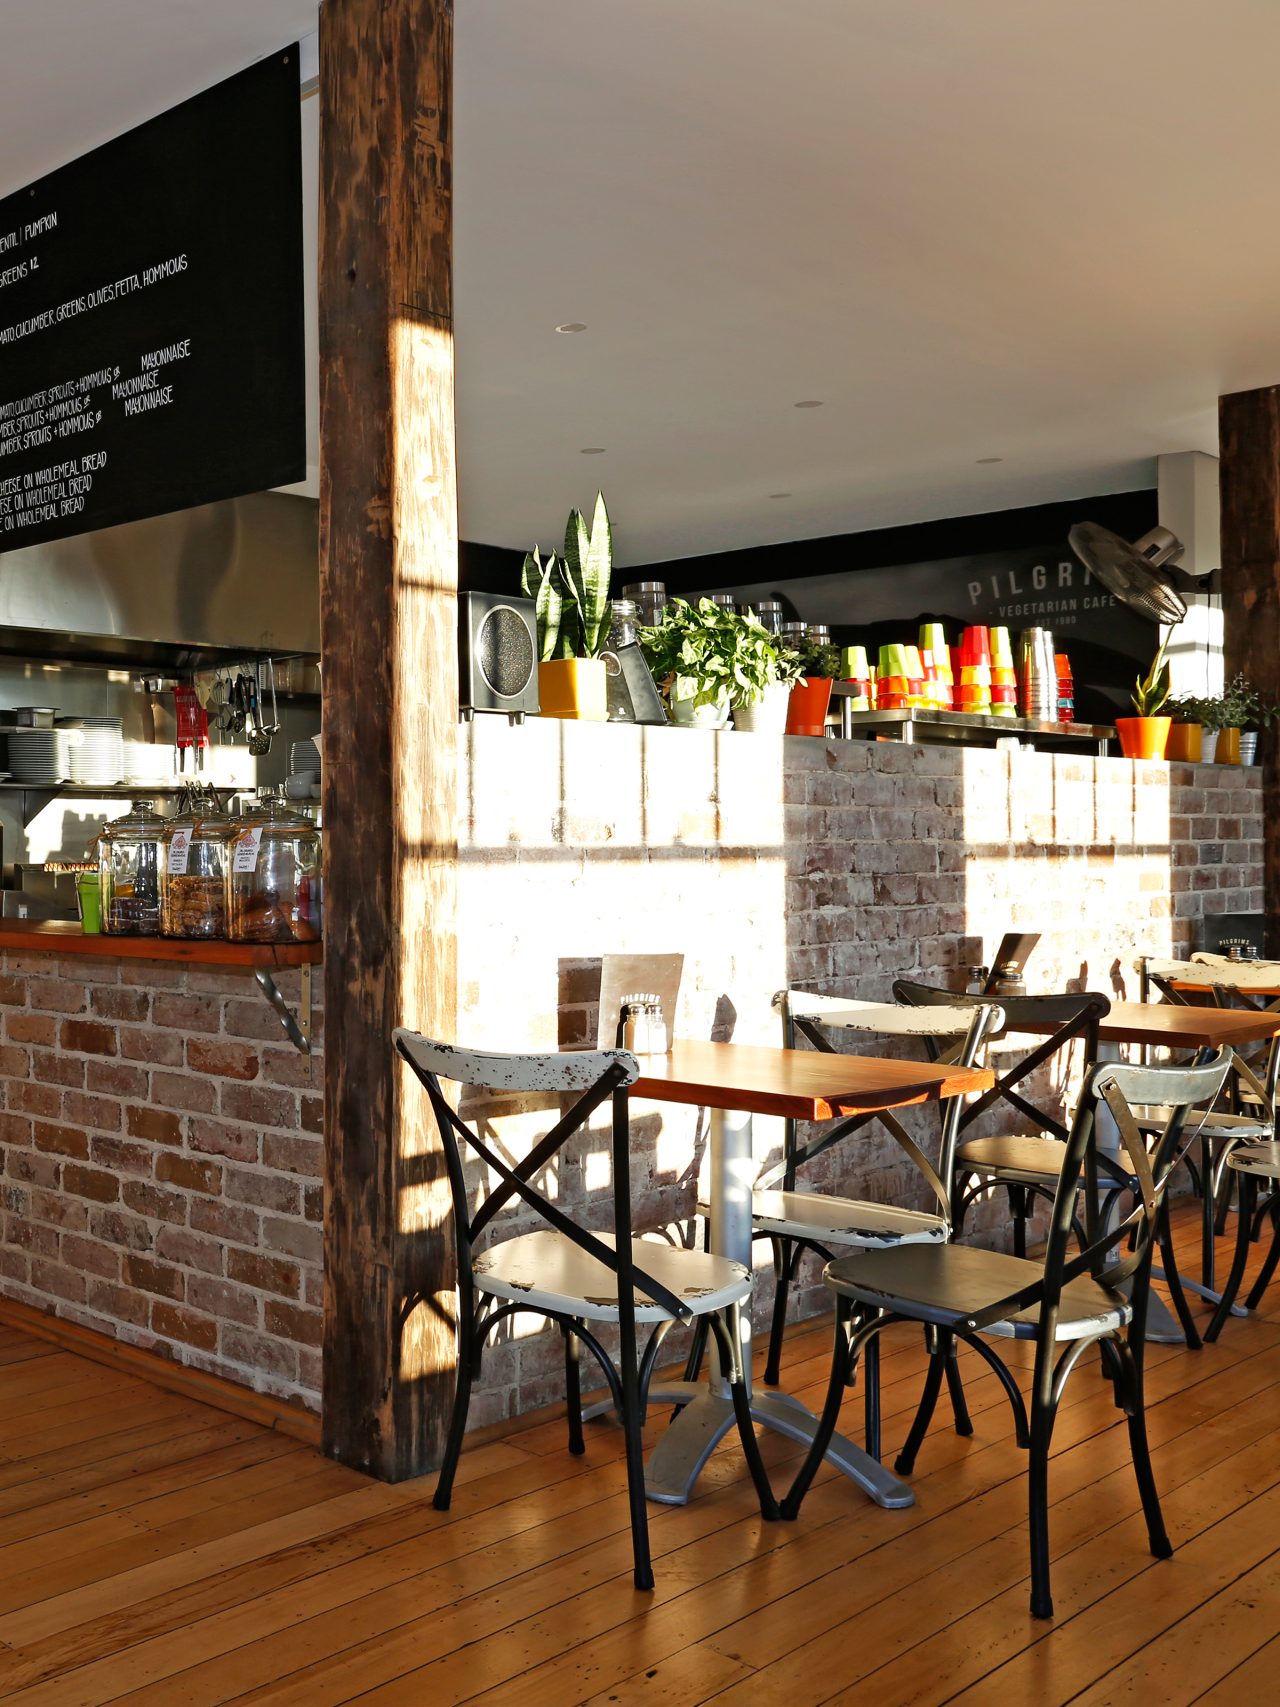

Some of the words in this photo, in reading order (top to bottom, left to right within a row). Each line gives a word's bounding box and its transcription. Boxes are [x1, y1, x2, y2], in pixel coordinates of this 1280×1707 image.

[25, 212, 57, 241] PUMPKIN
[30, 257, 39, 270] 12
[143, 254, 188, 286] HOMMOUS
[47, 380, 75, 405] SPROUTS
[141, 338, 191, 374] MAYONNAISE
[16, 409, 45, 435] SPROUTS
[112, 369, 160, 400] MAYONNAISE
[23, 425, 52, 449] SPROUTS
[58, 411, 95, 438] HOMMOUS
[124, 385, 174, 417] MAYONNAISE
[23, 473, 33, 489] ON
[34, 459, 80, 486] WHOLEMEAL
[81, 451, 107, 473] BREAD
[14, 493, 24, 511] ON
[25, 482, 68, 508] WHOLEMEAL
[68, 474, 92, 498] BREAD
[4, 514, 15, 531] ON
[16, 503, 59, 528] WHOLEMEAL
[60, 496, 85, 517] BREAD
[999, 599, 1077, 617] VEGETARIAN
